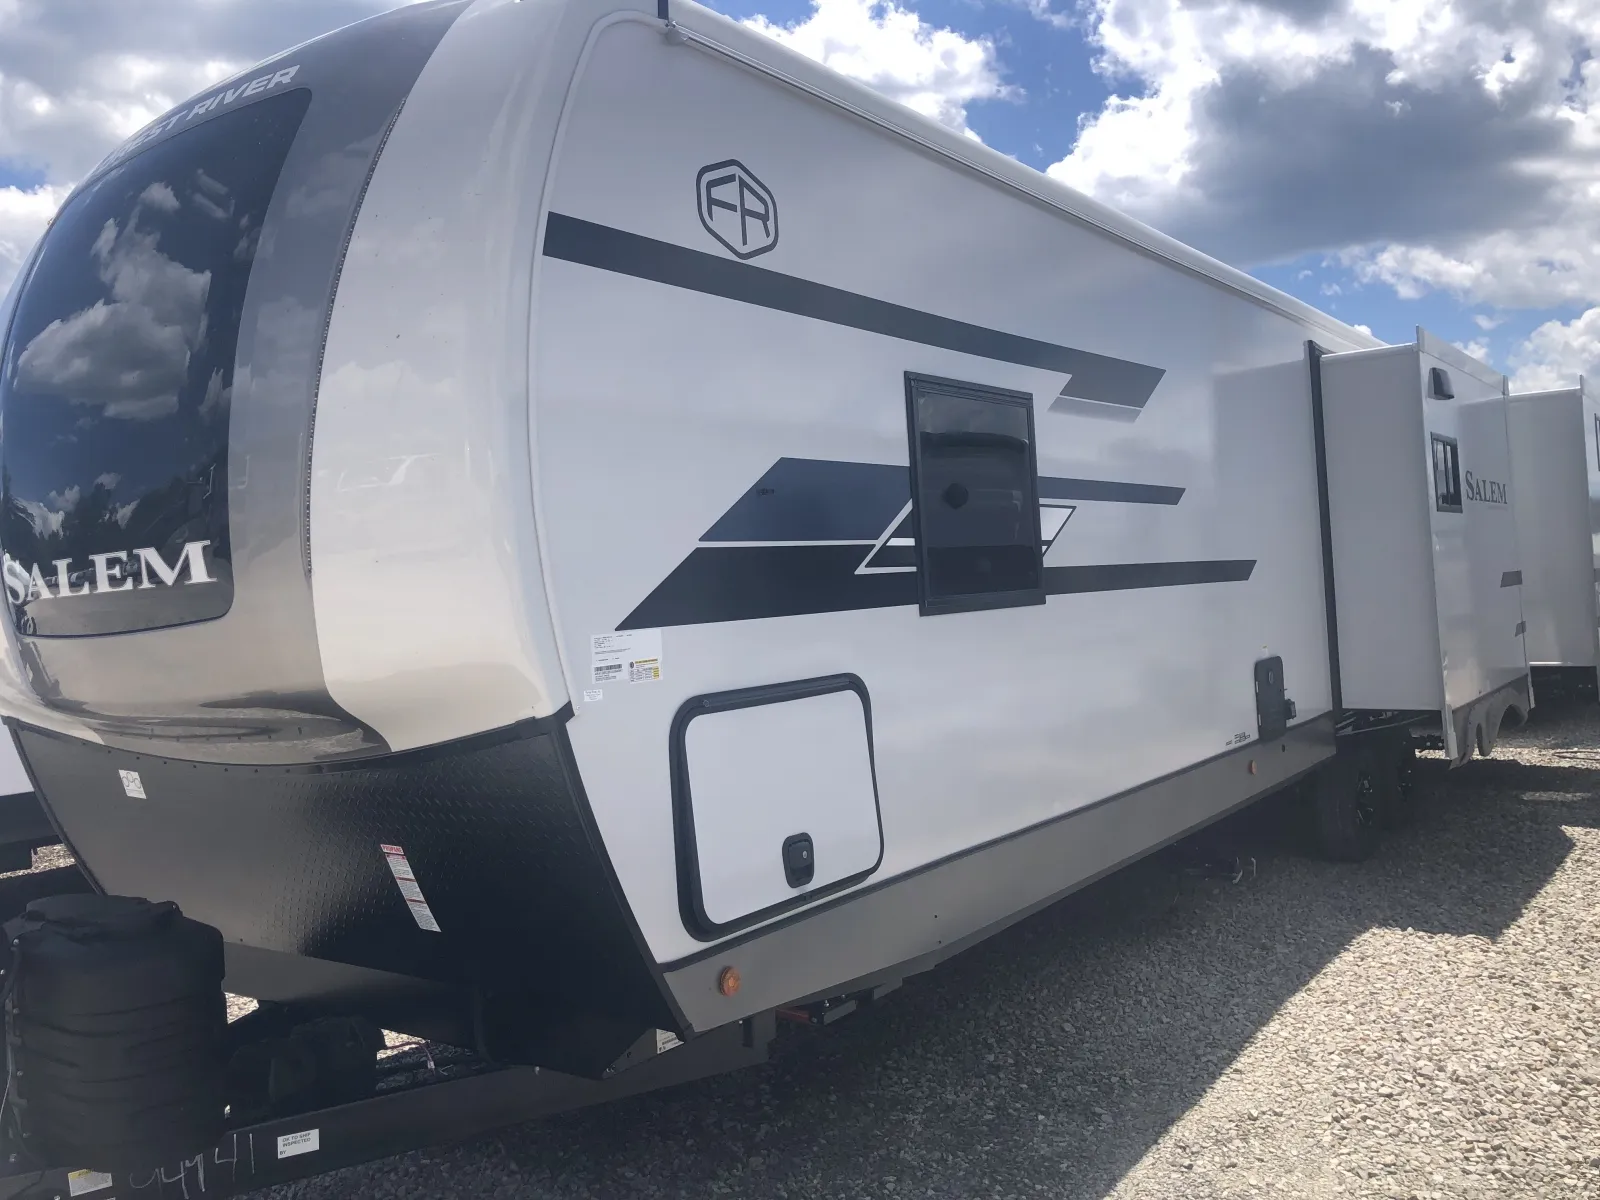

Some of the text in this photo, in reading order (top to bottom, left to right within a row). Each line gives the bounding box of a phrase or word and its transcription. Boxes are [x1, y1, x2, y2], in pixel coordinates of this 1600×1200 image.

[186, 65, 300, 121] RIVER
[1465, 470, 1508, 505] SALEM
[3, 540, 217, 605] SALEM
[282, 1138, 311, 1148] INSPECTED
